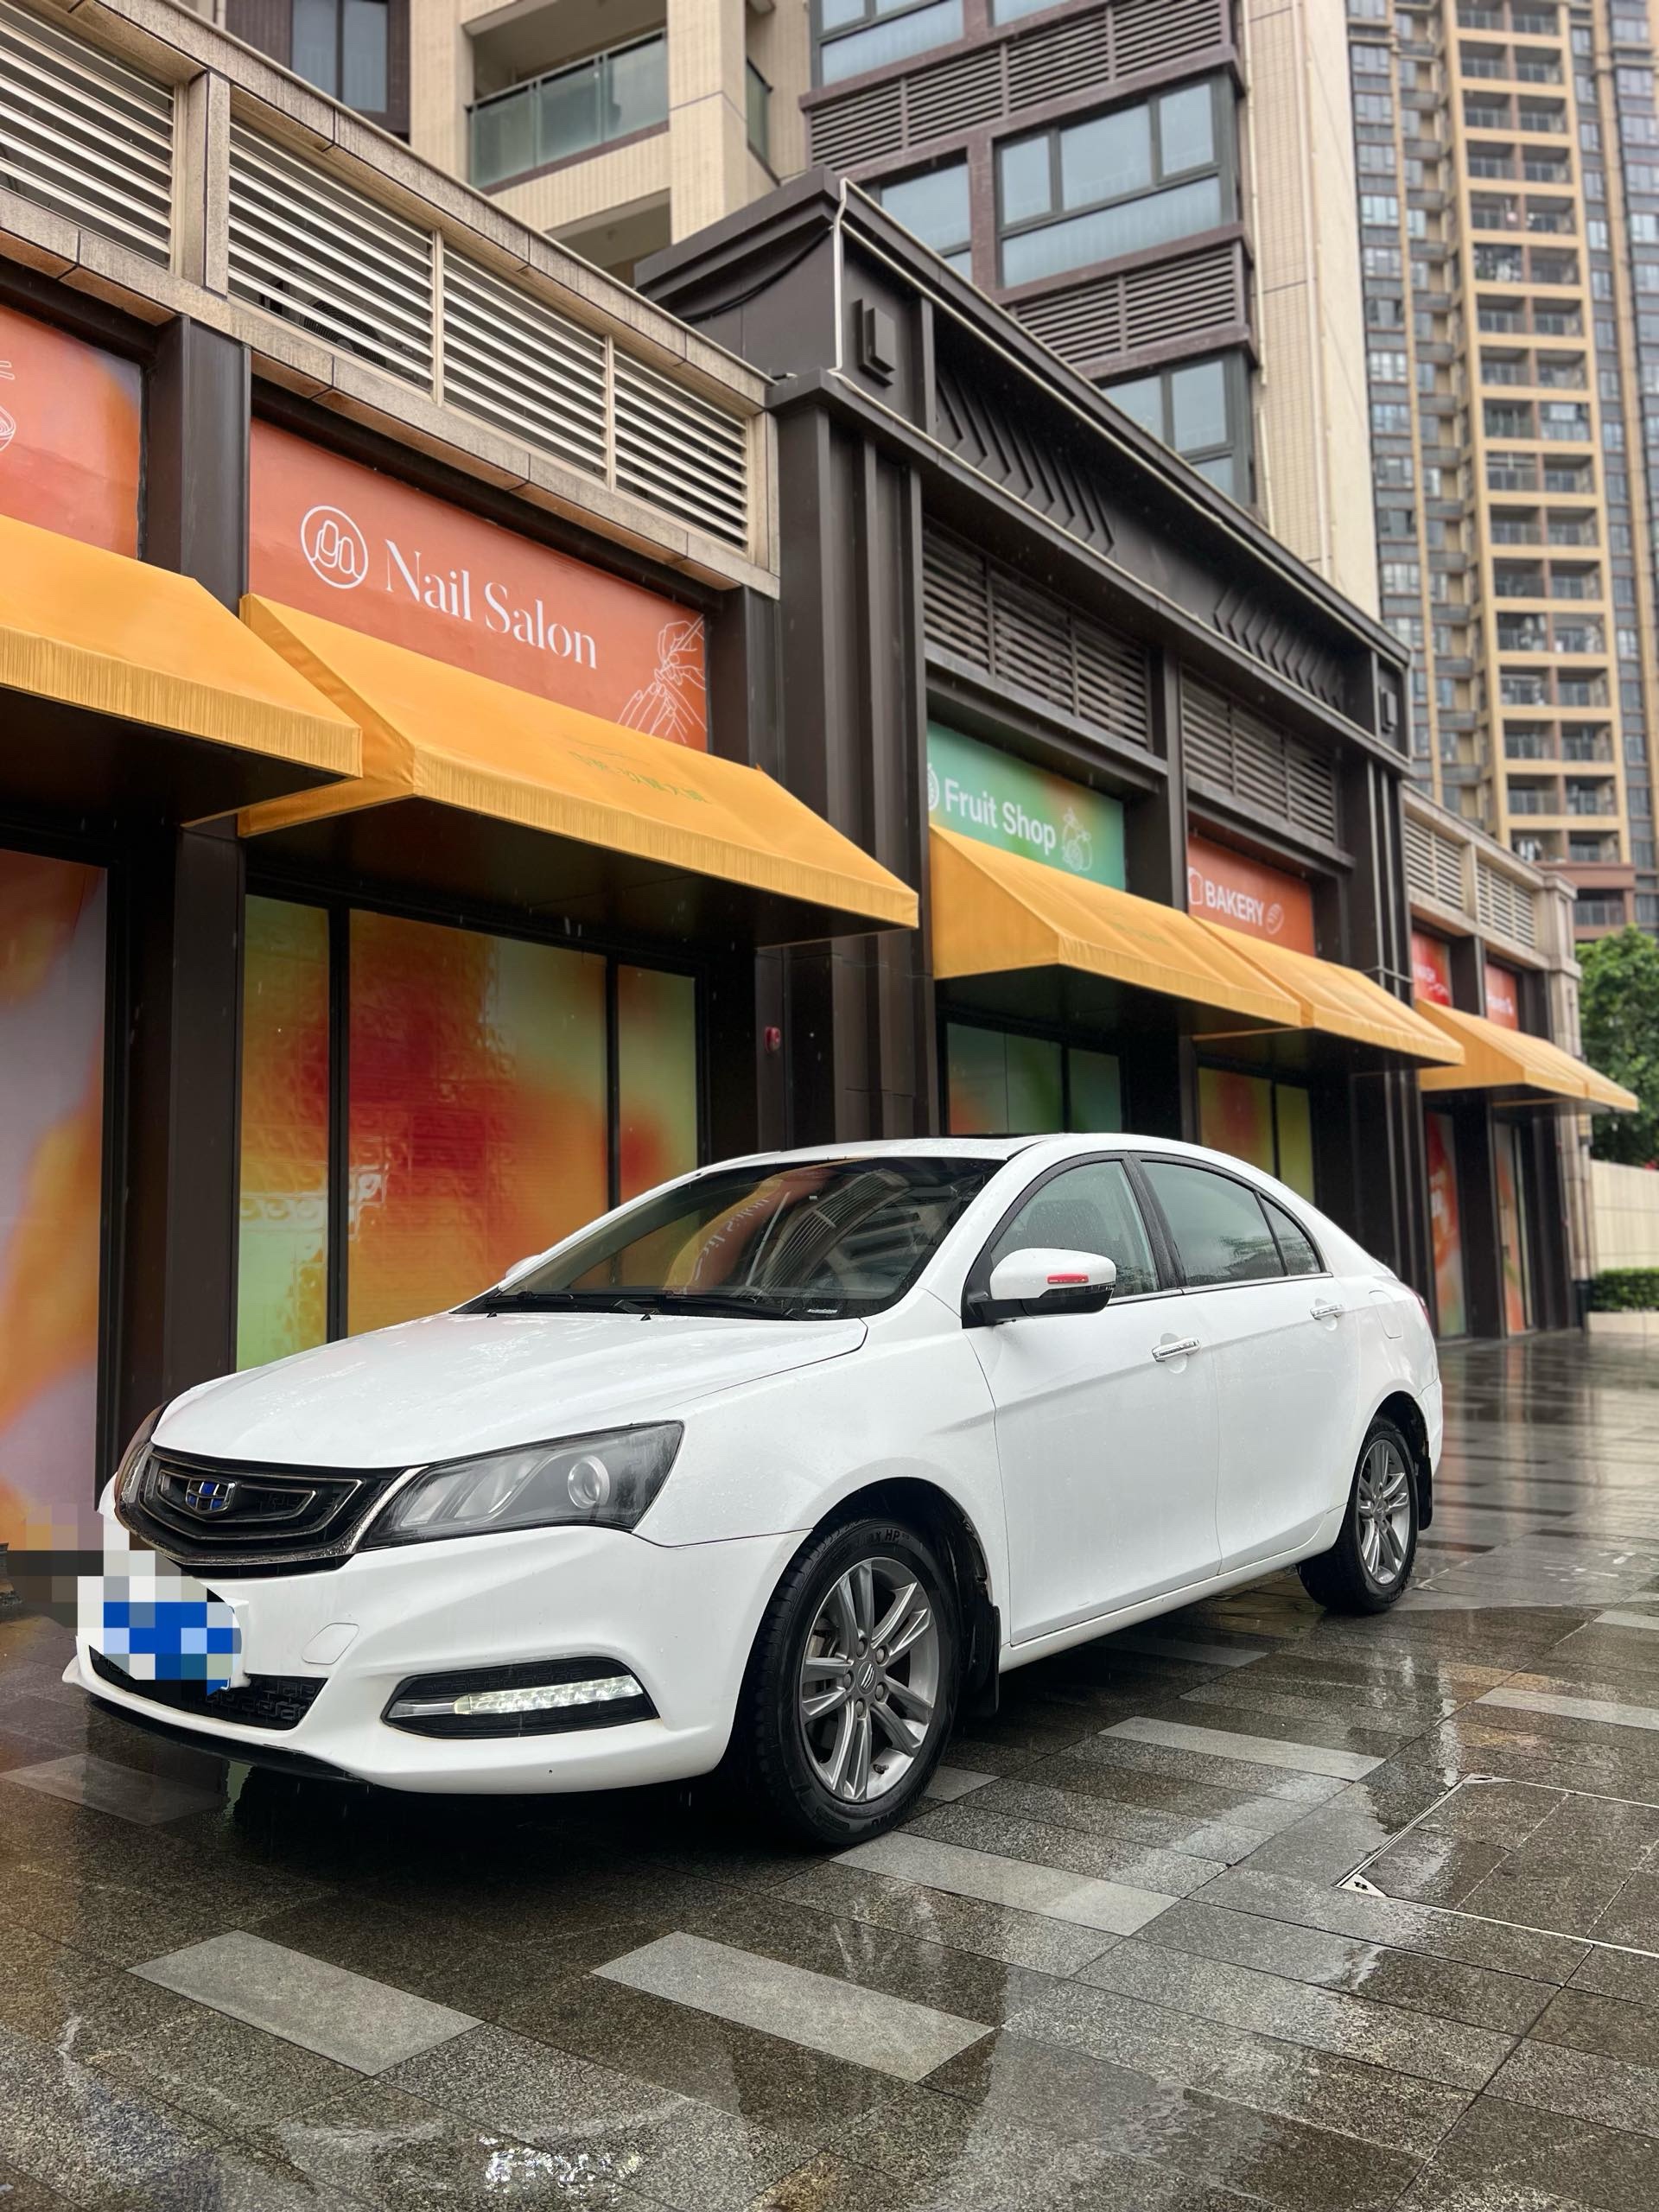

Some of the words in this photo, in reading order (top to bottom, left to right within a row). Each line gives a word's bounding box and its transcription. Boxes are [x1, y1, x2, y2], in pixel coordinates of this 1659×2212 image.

[385, 538, 474, 622] Nail
[484, 582, 597, 670] Salon
[944, 777, 997, 830] Fruit
[1001, 801, 1057, 855] Shop
[1205, 880, 1264, 927] BAKERY
[884, 1529, 900, 1542] HP
